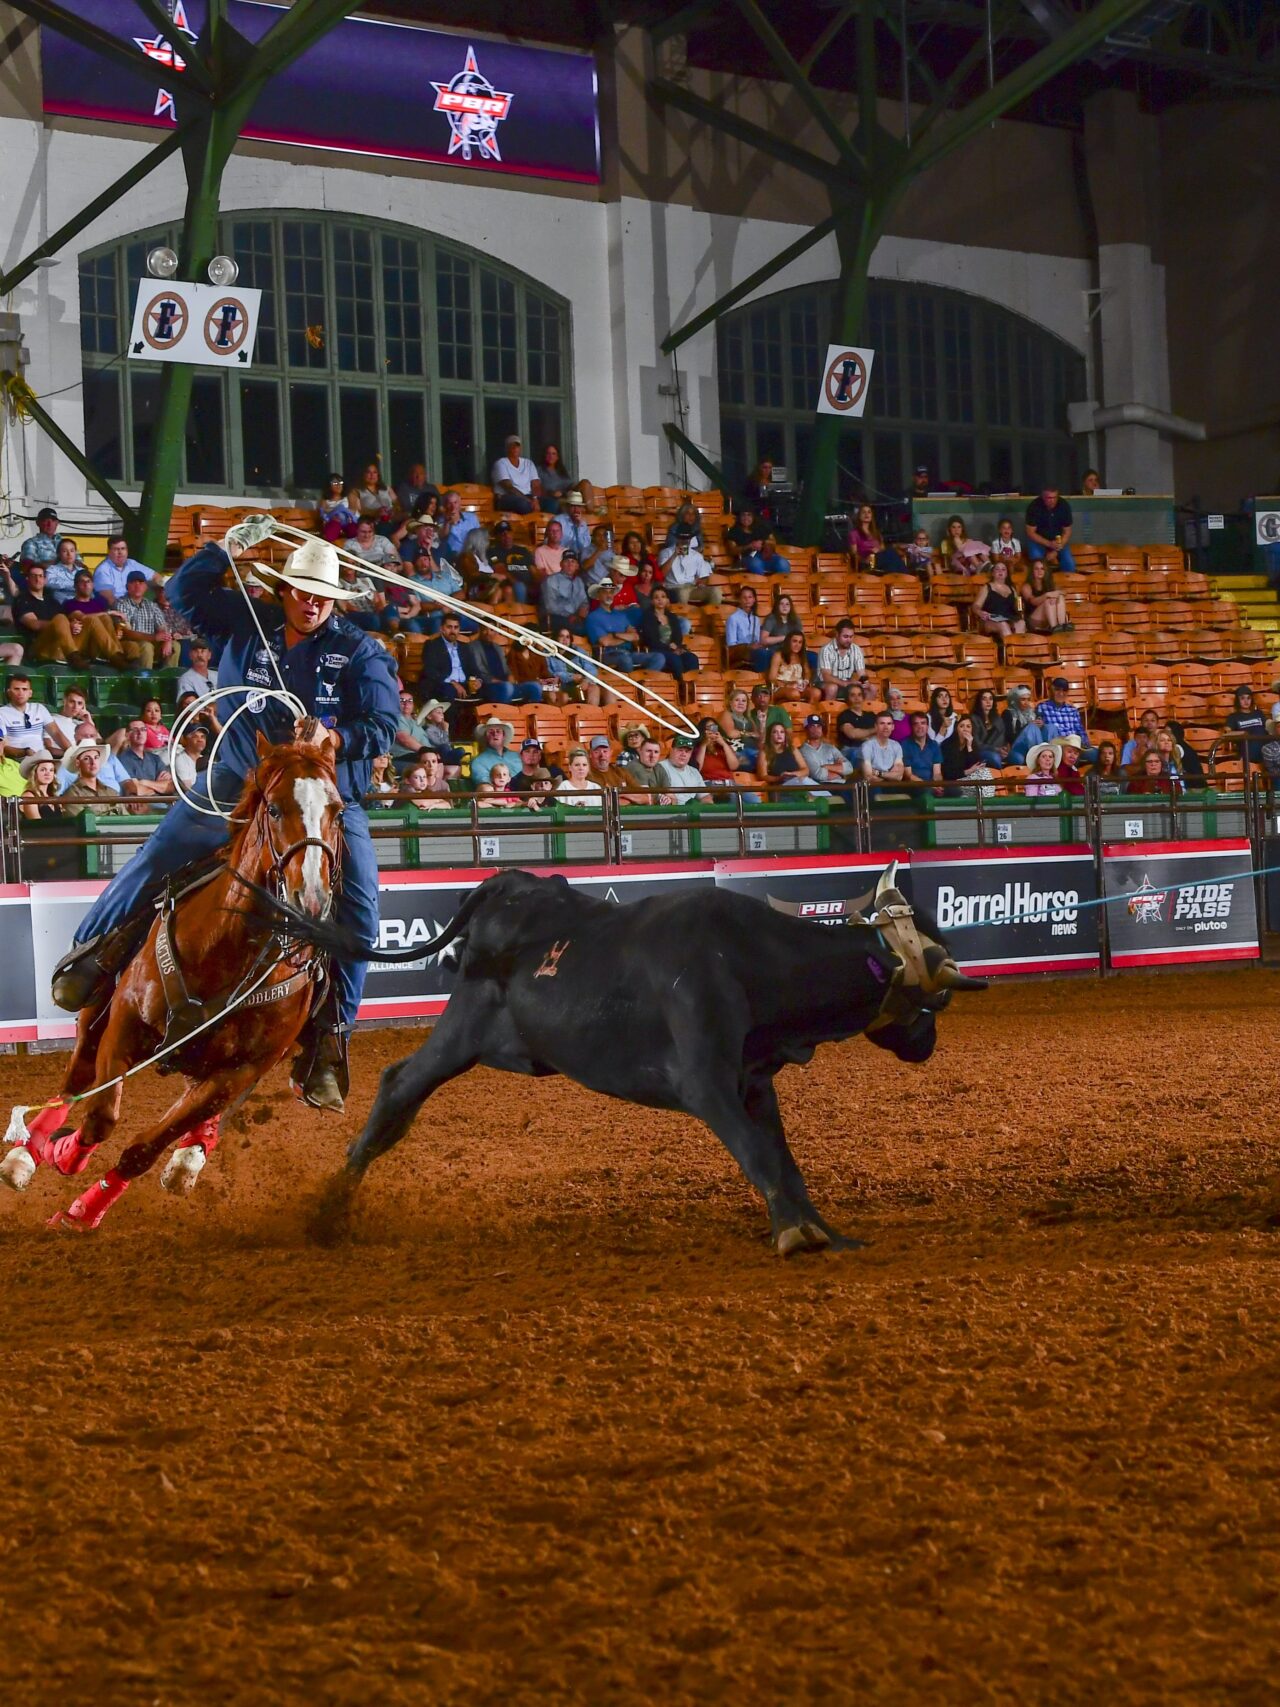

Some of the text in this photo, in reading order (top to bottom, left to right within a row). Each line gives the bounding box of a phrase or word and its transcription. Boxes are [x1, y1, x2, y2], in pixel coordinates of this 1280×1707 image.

[441, 94, 505, 112] PBR
[486, 847, 494, 856] 29
[1176, 884, 1234, 903] RIDE
[801, 902, 843, 915] PBR
[1173, 901, 1231, 920] PASS
[1052, 922, 1078, 936] news
[157, 933, 176, 976] CACTUS
[369, 961, 414, 971] ALLIANCE
